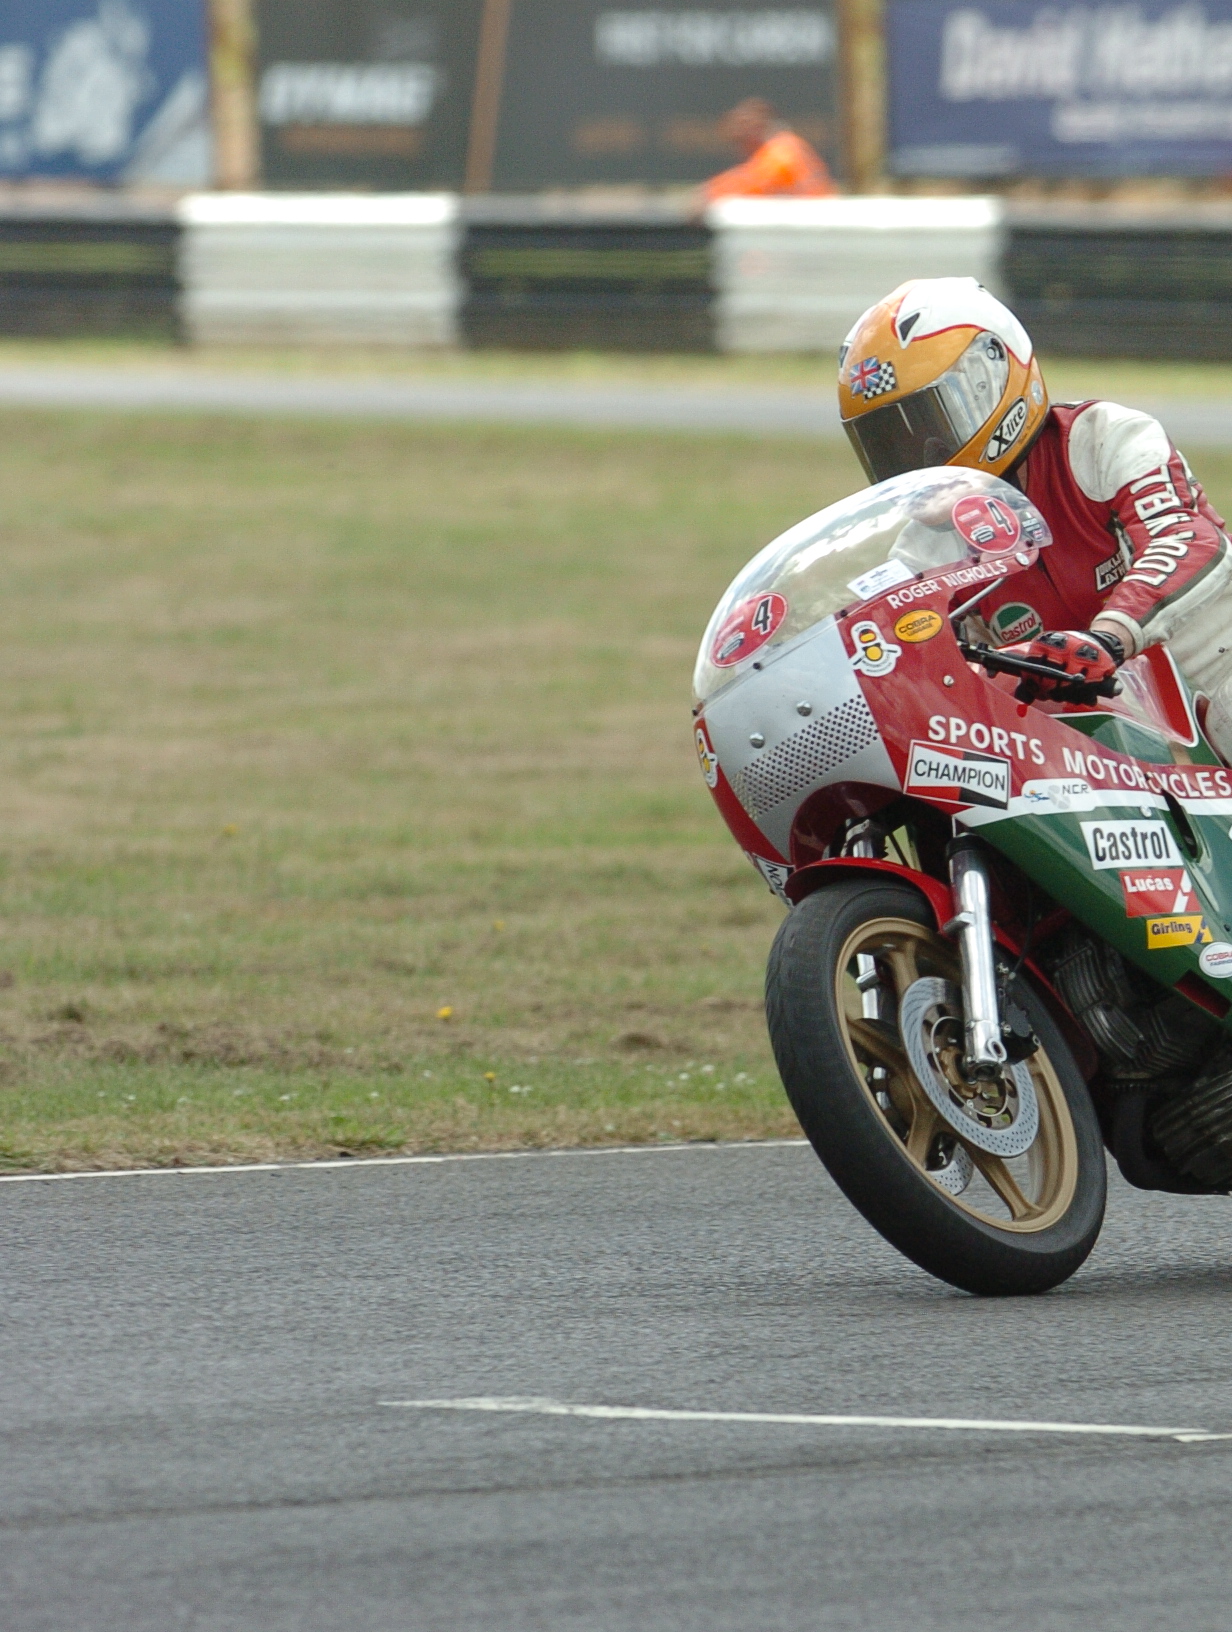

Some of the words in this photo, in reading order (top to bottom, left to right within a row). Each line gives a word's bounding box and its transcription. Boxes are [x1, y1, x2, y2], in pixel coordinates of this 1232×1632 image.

[941, 8, 1080, 101] David
[992, 405, 1025, 457] X-lite
[984, 499, 1015, 536] 4
[886, 580, 942, 609] ROGER
[941, 560, 1008, 588] NICHOLLS
[751, 596, 773, 635] 4
[899, 614, 937, 634] COBRA
[1001, 613, 1036, 641] Castrol
[928, 715, 1045, 765] SPORTS
[1062, 747, 1232, 797] MOTORCYCLES
[914, 759, 1005, 791] CHAMPION
[1092, 826, 1171, 862] Castrol
[1124, 875, 1174, 893] Lucas
[1151, 921, 1193, 936] Girling
